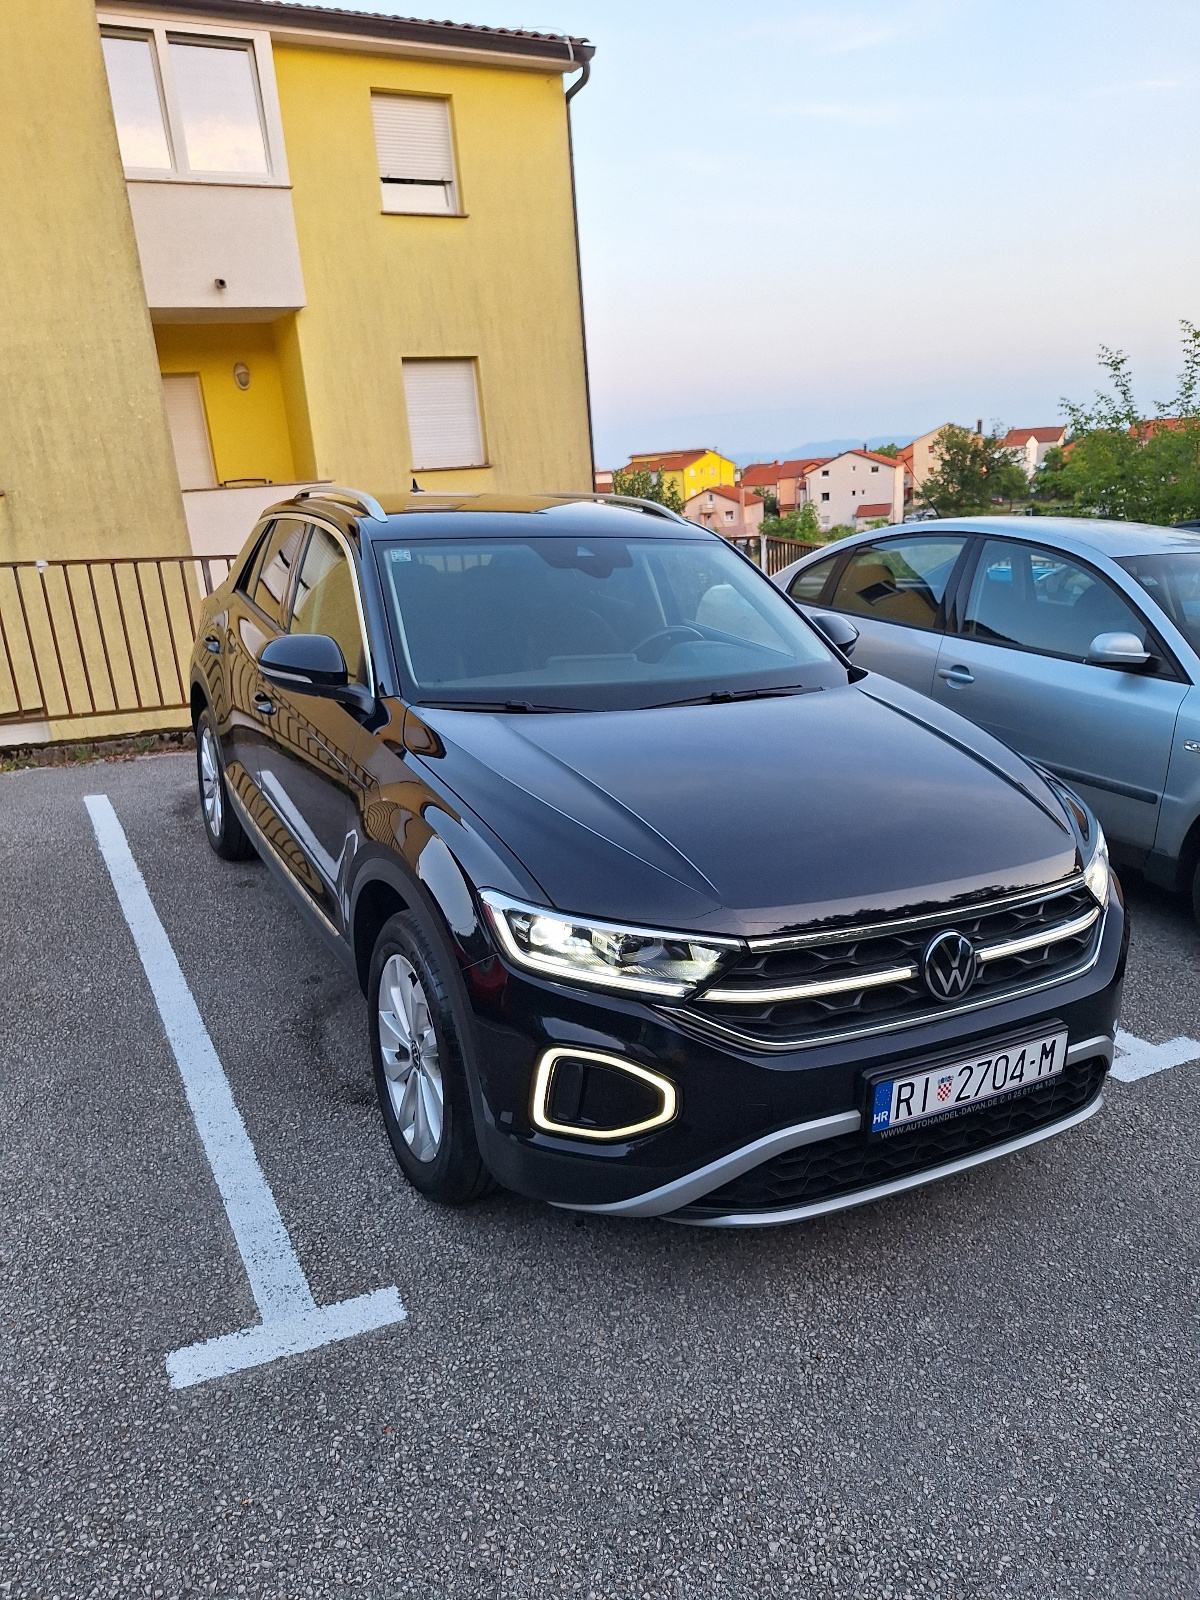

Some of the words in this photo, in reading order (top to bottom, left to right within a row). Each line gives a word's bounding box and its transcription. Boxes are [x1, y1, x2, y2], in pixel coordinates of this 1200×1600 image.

[928, 933, 974, 998] VW
[894, 1077, 930, 1120] RI
[955, 1039, 1057, 1103] 2704-M
[873, 1110, 888, 1125] HR
[880, 1097, 998, 1140] WWW.AUTOHANDEL-DAYAN.DE
